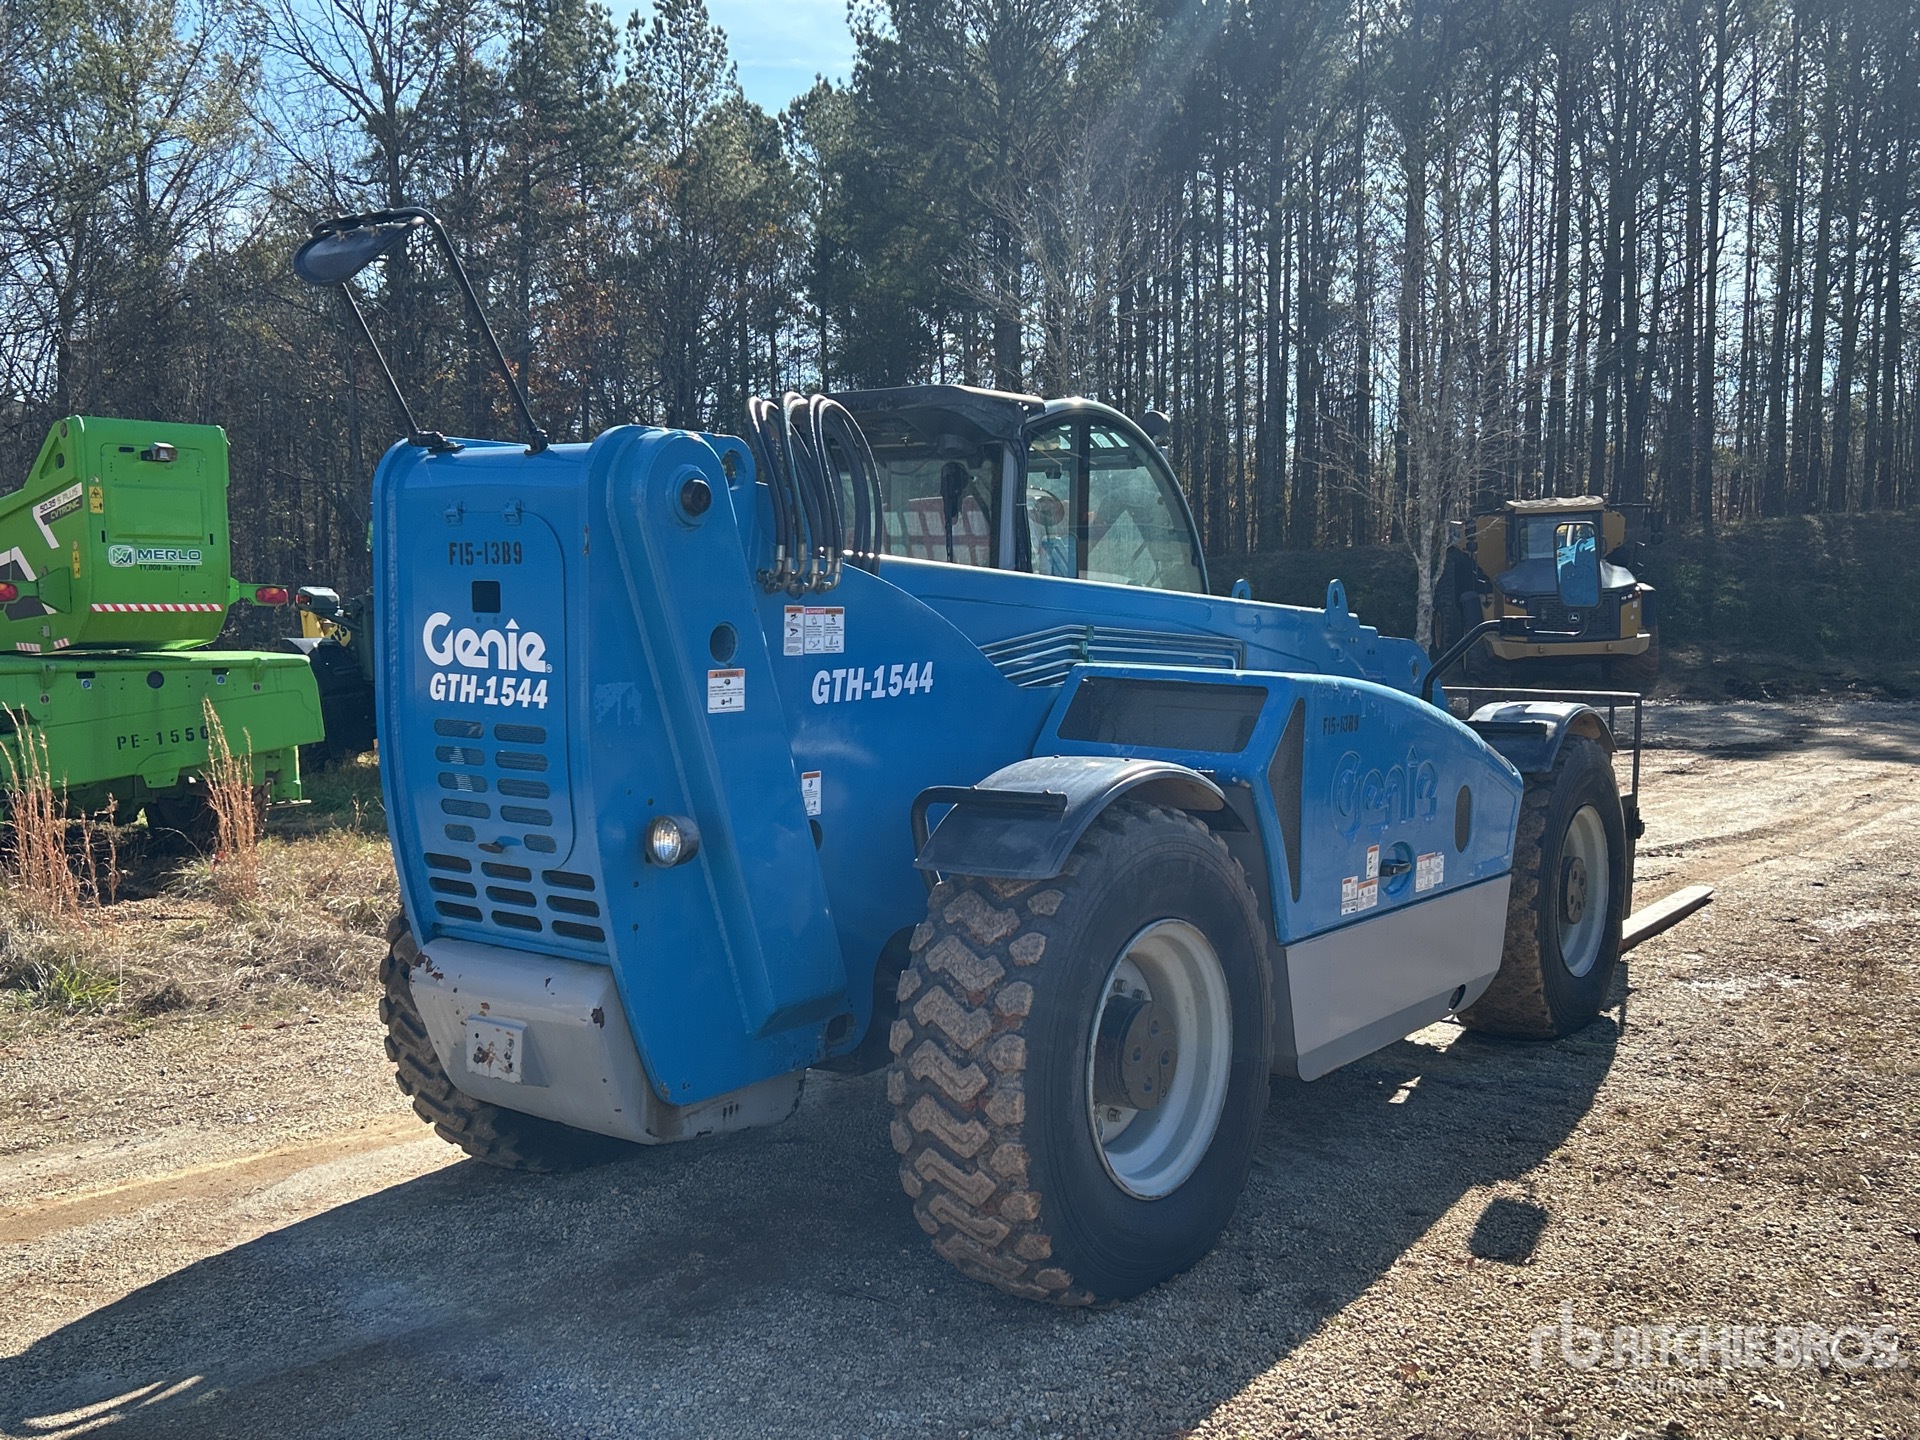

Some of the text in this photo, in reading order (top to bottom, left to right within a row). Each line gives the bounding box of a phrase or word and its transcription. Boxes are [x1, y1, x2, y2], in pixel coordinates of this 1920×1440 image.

[137, 549, 201, 561] MERLO
[139, 564, 161, 572] 11,000
[448, 541, 523, 566] F15-13B9
[422, 612, 548, 673] Genie
[429, 672, 549, 709] GTH-1544
[811, 661, 934, 705] GTH-1544
[116, 725, 209, 750] PE-1550
[1331, 745, 1439, 836] Genie
